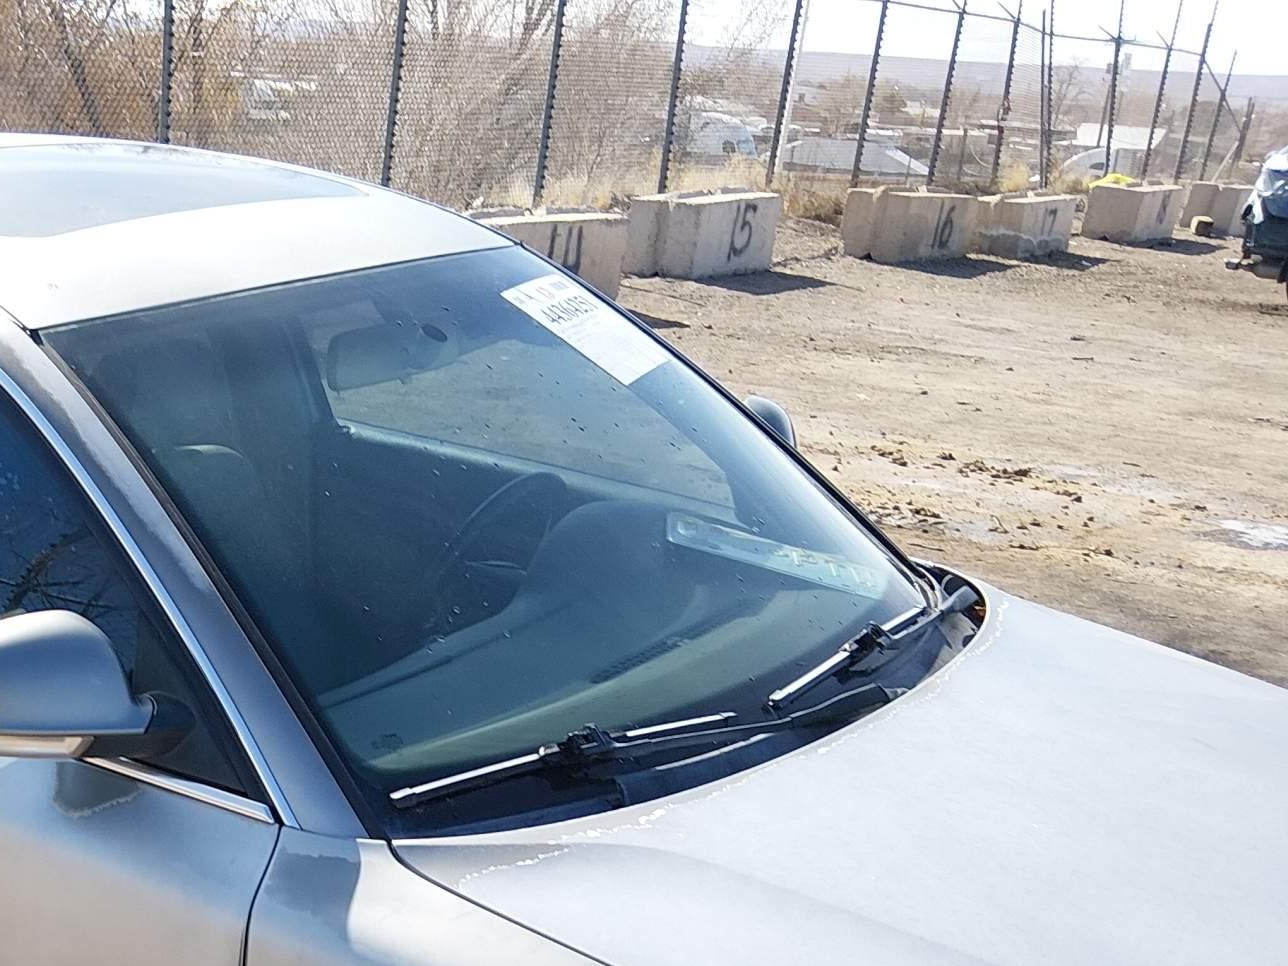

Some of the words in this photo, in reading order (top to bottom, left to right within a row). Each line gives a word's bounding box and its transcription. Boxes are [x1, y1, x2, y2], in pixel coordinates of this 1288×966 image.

[726, 202, 758, 262] 15
[931, 200, 957, 250] 16
[1039, 206, 1059, 237] 17
